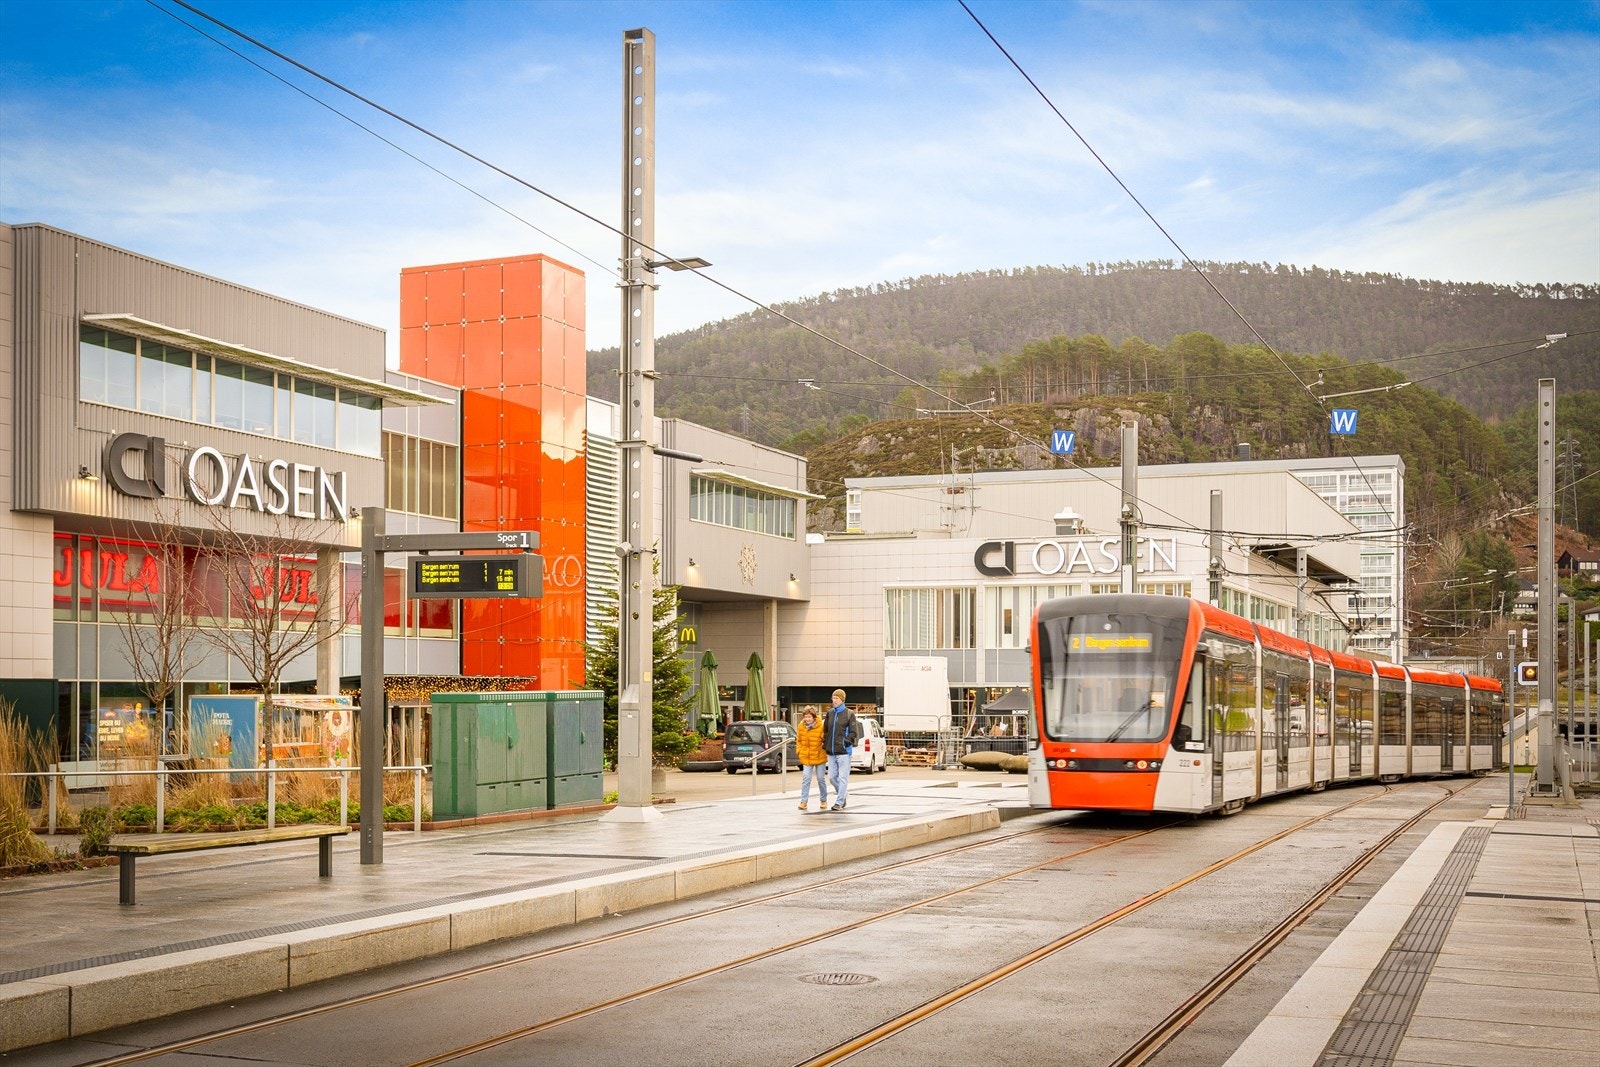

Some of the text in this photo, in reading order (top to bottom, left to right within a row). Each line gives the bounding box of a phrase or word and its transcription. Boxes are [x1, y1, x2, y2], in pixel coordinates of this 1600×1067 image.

[1333, 411, 1356, 432] W
[1054, 431, 1075, 452] W
[186, 446, 347, 523] OASEN
[497, 532, 530, 548] Spor 1
[53, 547, 159, 593] JULA
[254, 566, 318, 605] JUL
[1072, 637, 1080, 649] 2
[1179, 759, 1190, 767] 222
